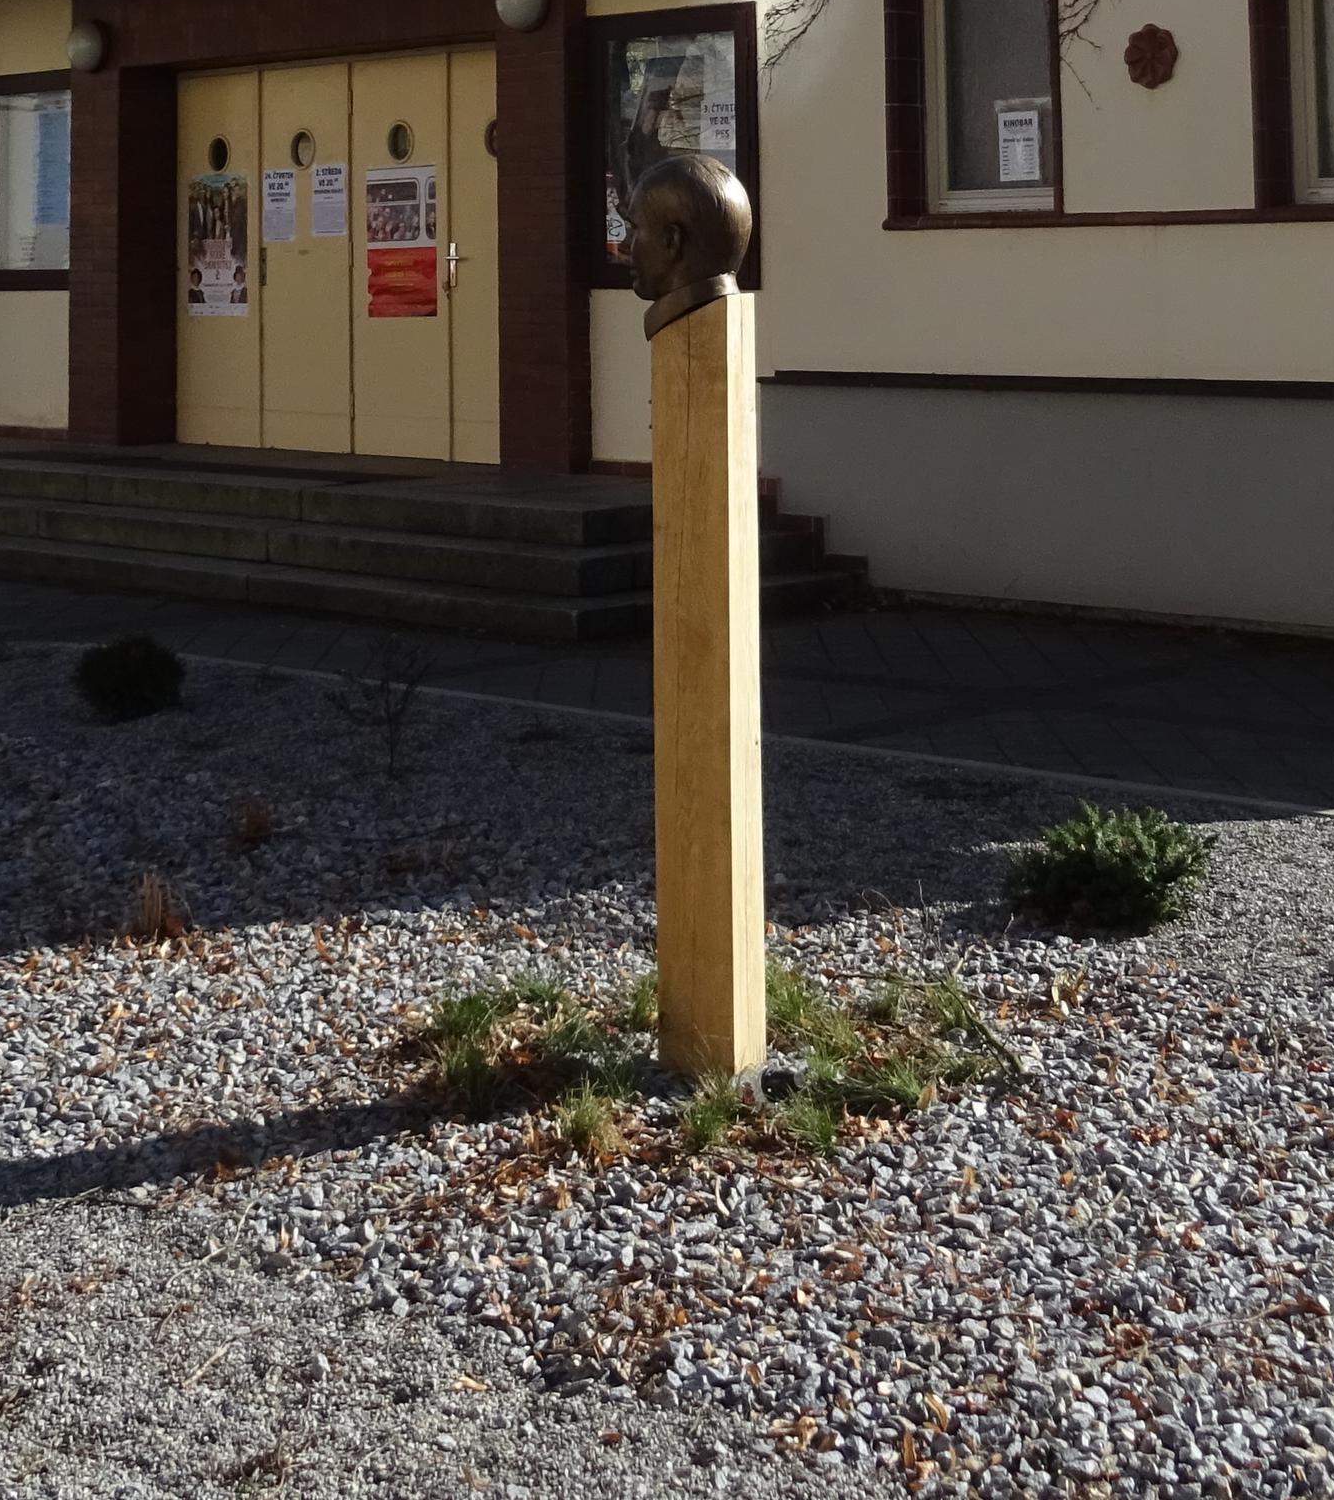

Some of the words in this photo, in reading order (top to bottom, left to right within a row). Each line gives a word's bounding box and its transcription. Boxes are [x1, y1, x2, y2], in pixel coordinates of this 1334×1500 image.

[711, 102, 735, 113] ČTVRT
[710, 116, 718, 125] VE
[1002, 118, 1033, 127] KINOBAR
[321, 166, 342, 176] STŘEDA
